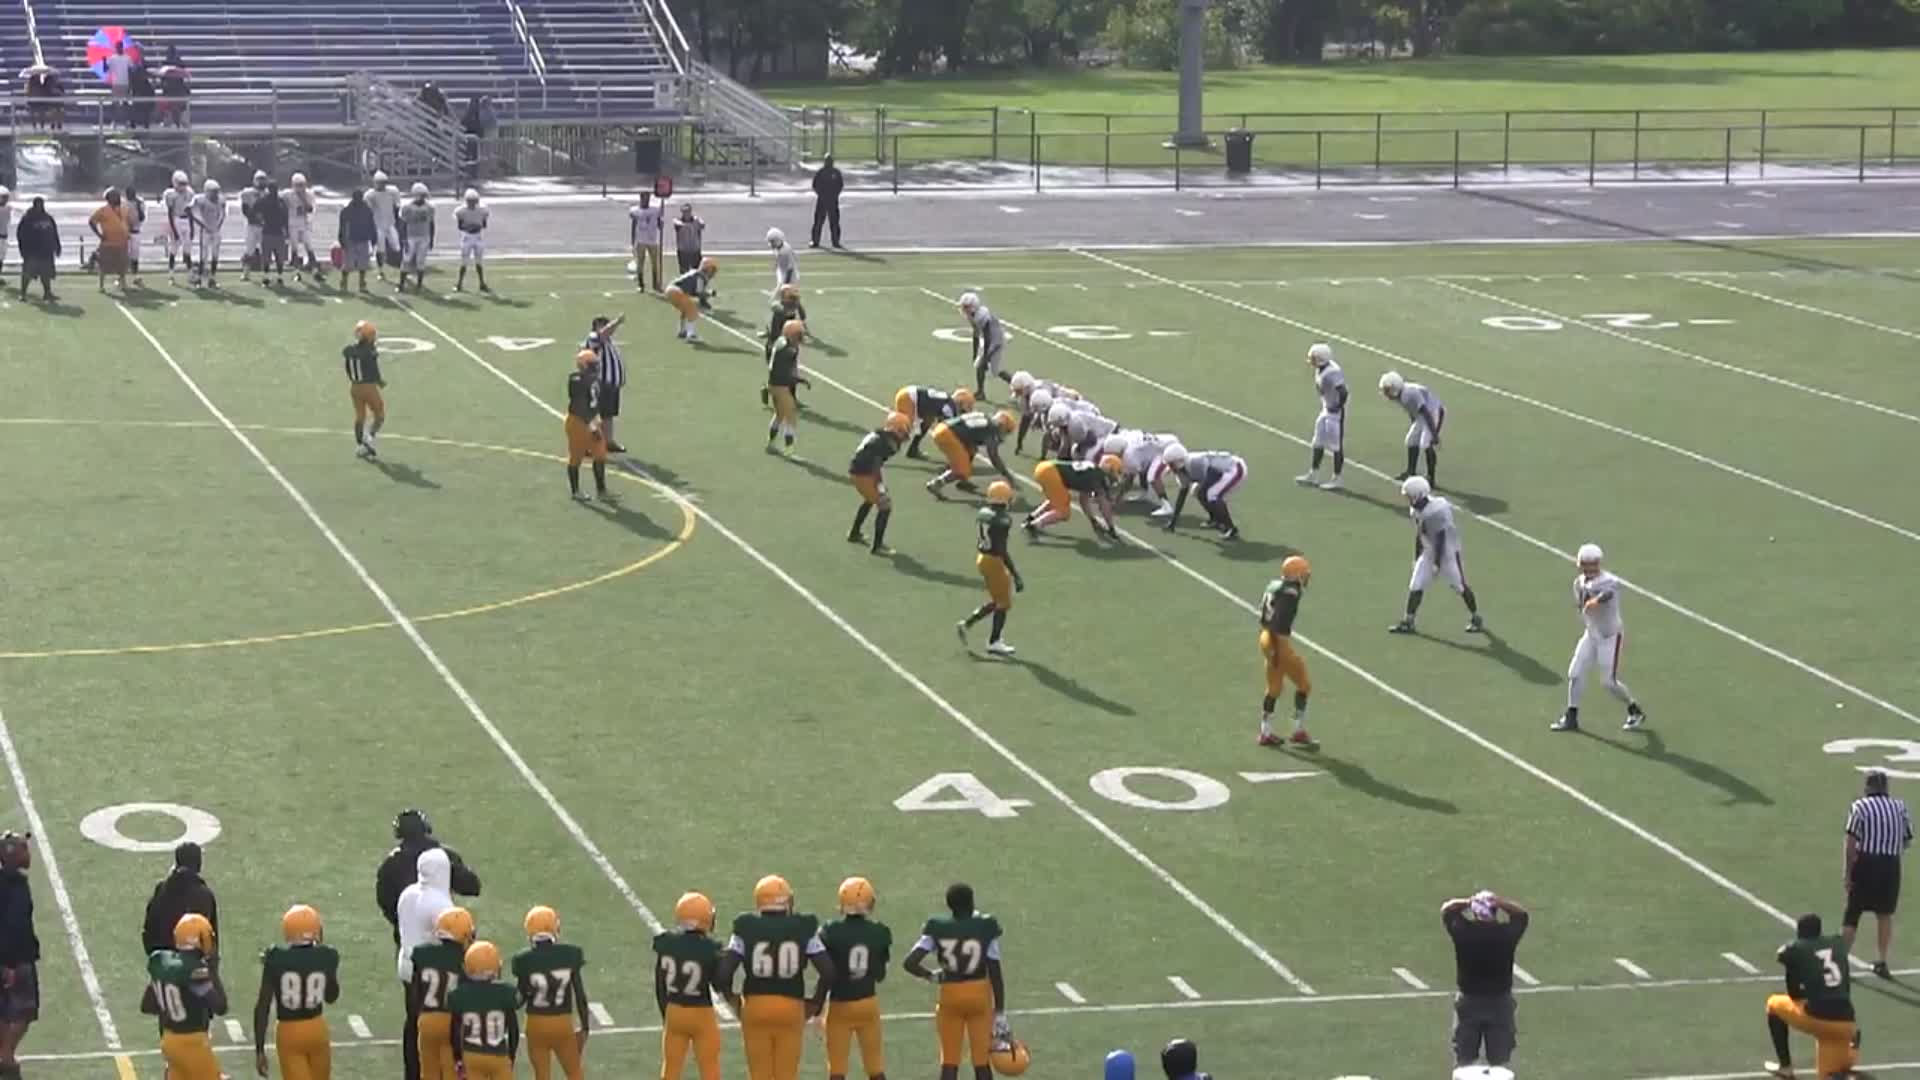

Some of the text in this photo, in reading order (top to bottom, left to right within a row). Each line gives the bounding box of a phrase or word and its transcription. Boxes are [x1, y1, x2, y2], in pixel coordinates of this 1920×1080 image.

[661, 956, 702, 996] 22
[752, 940, 799, 978] 60
[848, 944, 868, 980] 9
[1814, 948, 1841, 987] 3
[280, 972, 326, 1010] 88
[529, 968, 572, 1008] 27
